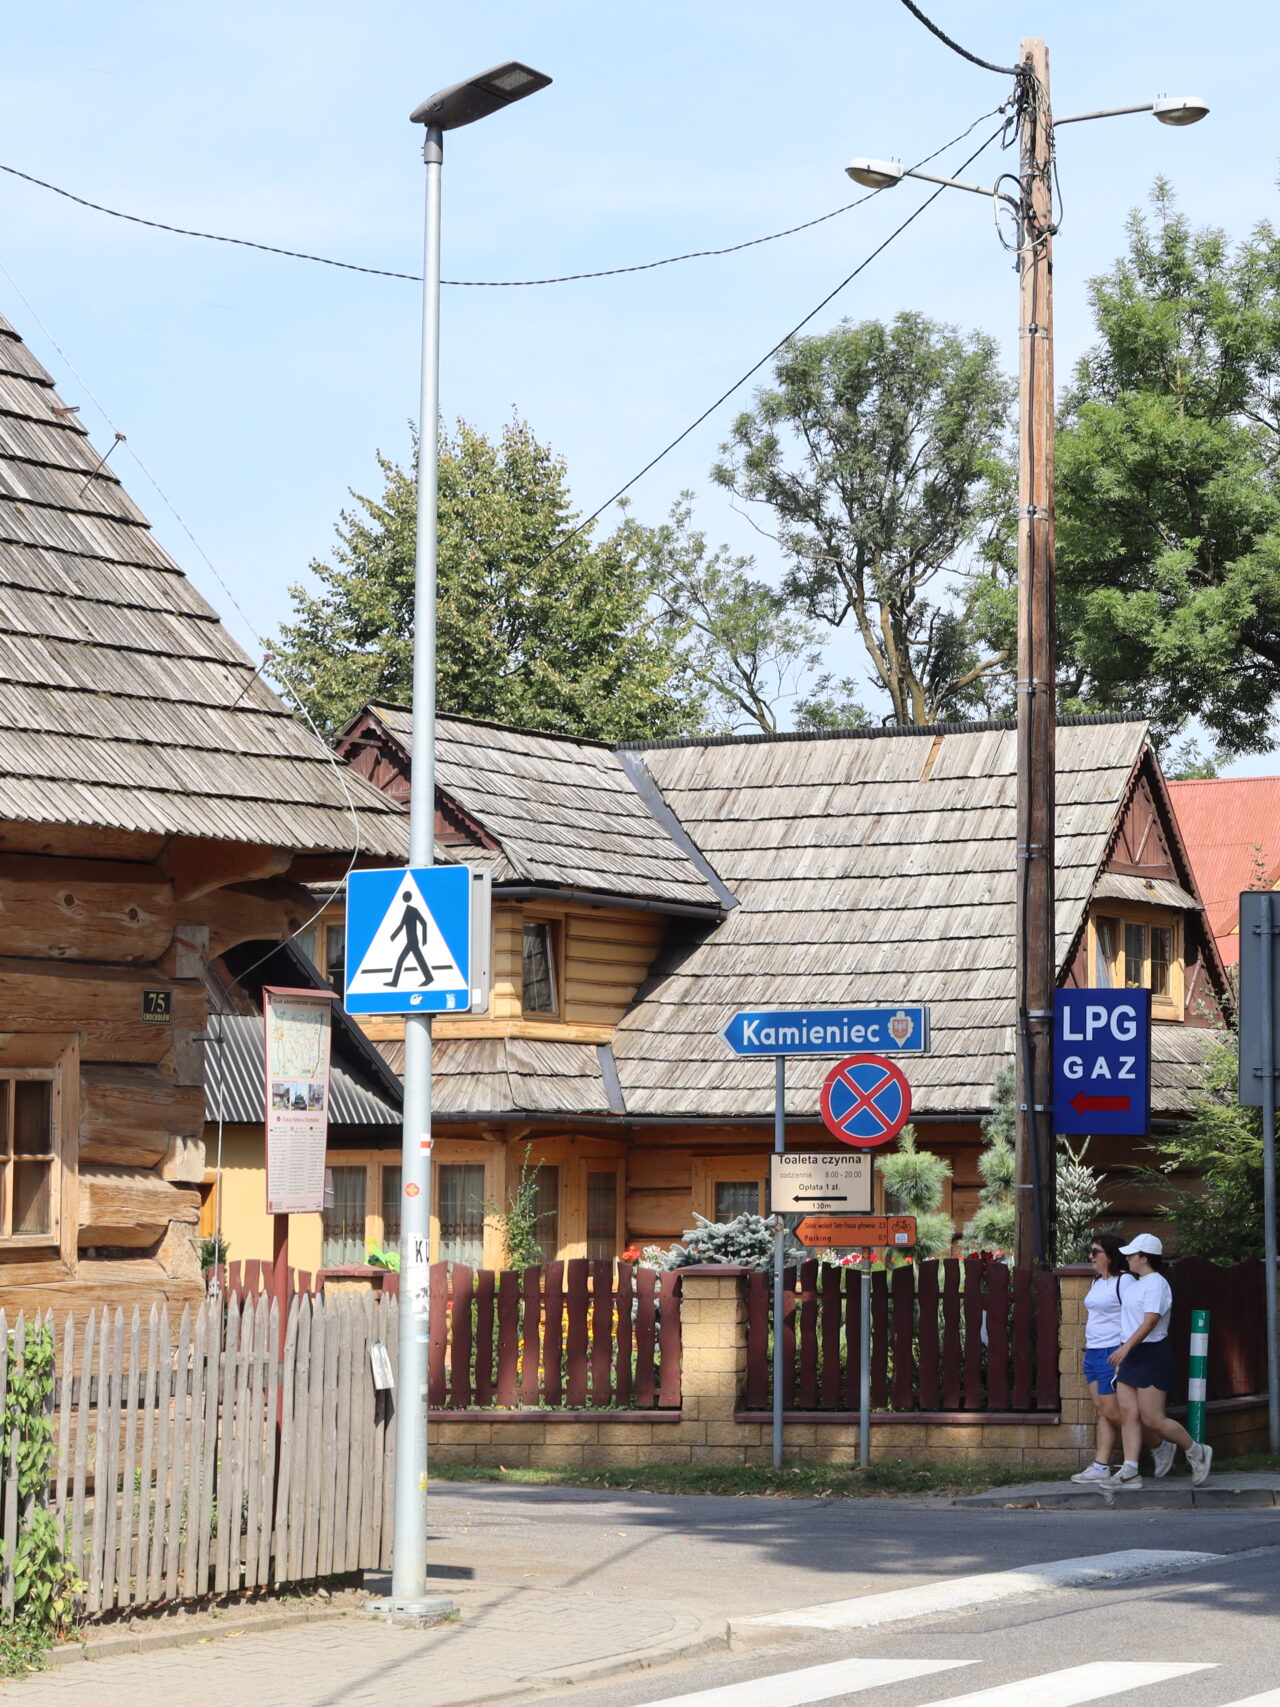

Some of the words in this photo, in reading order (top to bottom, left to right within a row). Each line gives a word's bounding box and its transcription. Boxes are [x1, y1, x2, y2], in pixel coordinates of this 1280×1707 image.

[148, 993, 165, 1013] 75
[1063, 1005, 1137, 1041] LPG
[743, 1017, 880, 1046] Kamieniec
[1063, 1055, 1136, 1079] GAZ
[779, 1155, 818, 1165] Toaleta
[821, 1155, 862, 1166] czynna
[779, 1171, 813, 1179] codziennie
[798, 1183, 823, 1191] Opłata
[804, 1234, 832, 1242] Parking
